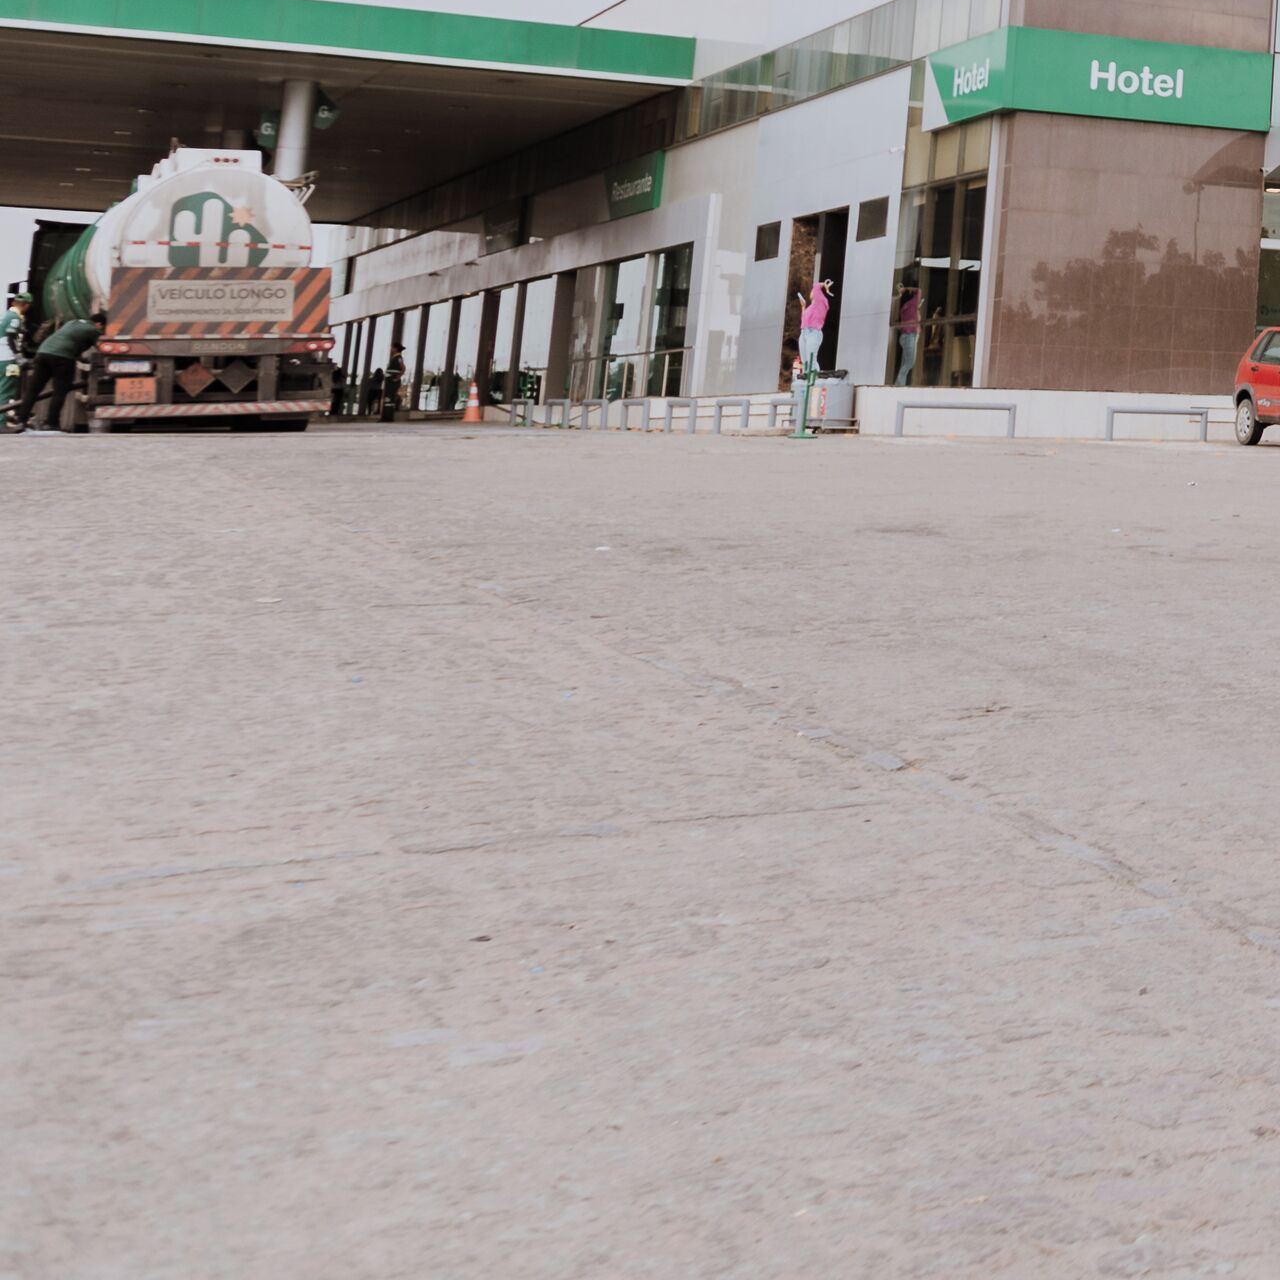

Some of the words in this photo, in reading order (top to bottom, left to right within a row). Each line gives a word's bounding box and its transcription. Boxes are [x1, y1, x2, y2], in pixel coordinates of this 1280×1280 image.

[953, 58, 990, 98] Hotel
[1089, 59, 1184, 99] Hotel
[611, 173, 653, 201] Restaurante
[230, 287, 287, 300] LONGO
